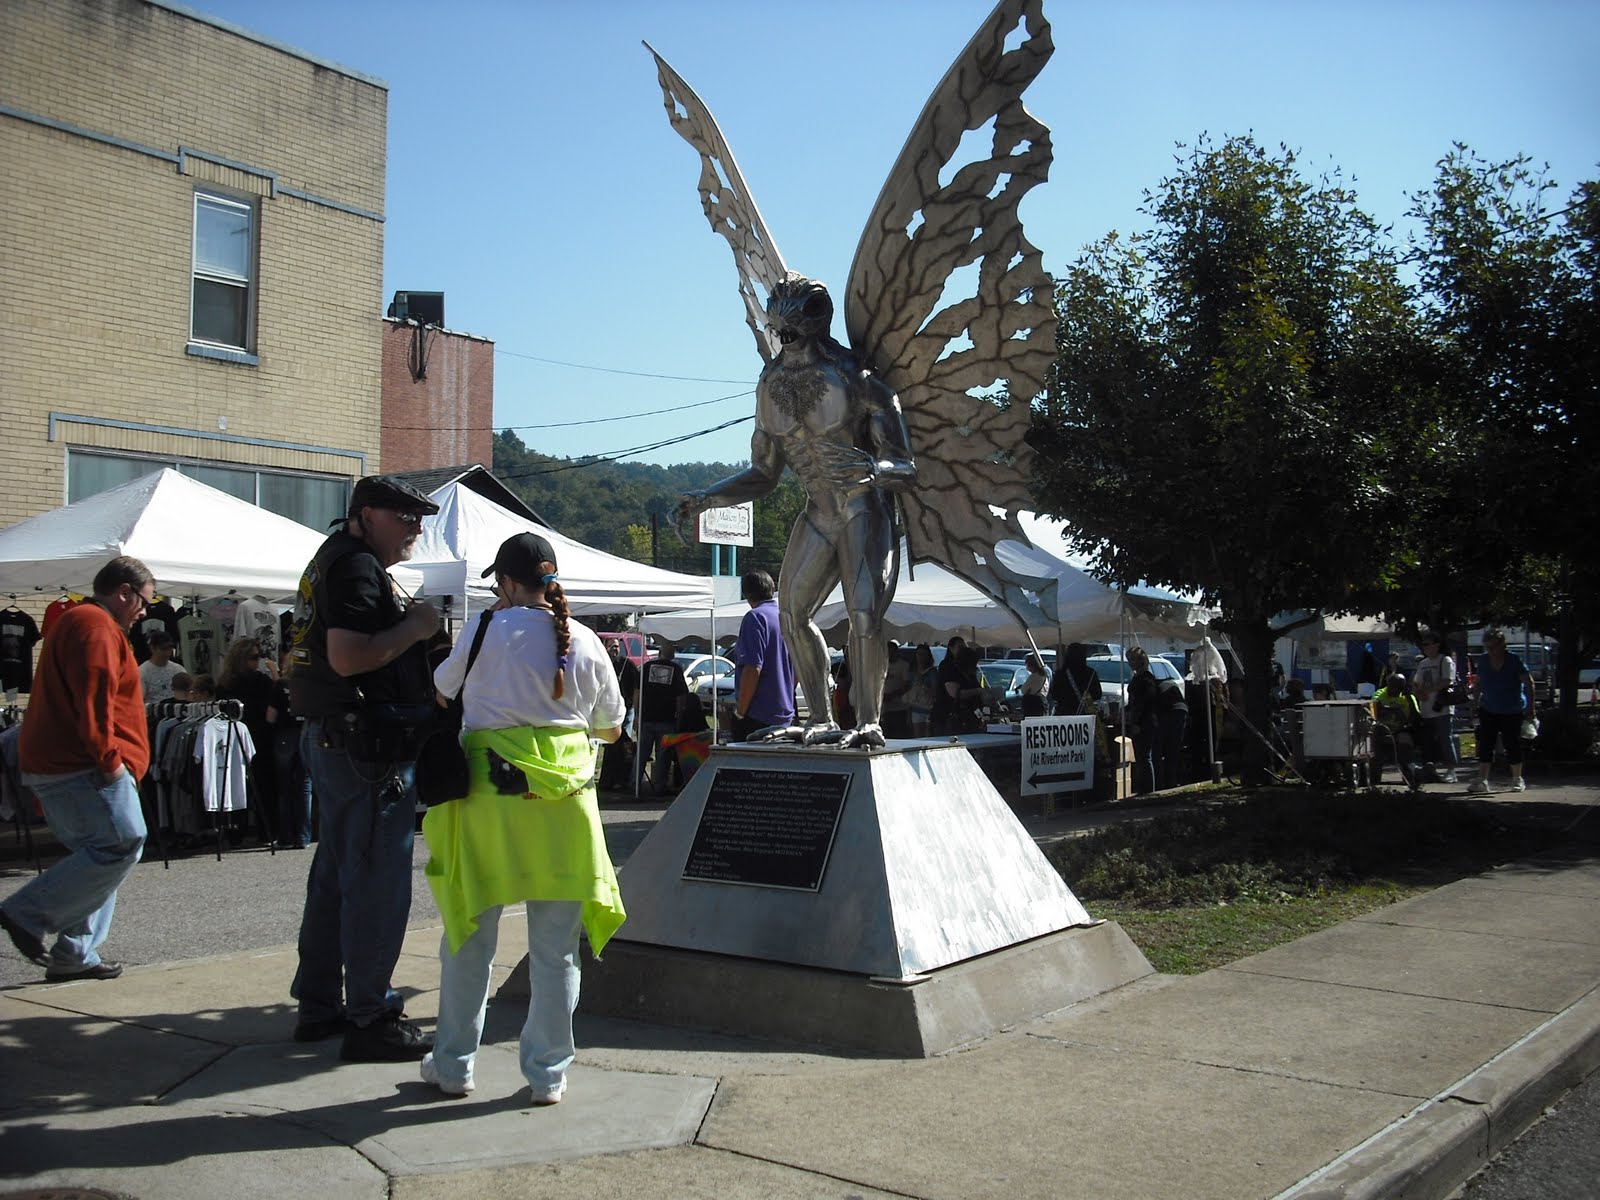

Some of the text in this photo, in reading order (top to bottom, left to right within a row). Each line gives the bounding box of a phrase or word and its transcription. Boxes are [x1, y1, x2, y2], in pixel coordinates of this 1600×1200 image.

[1026, 723, 1089, 749] RESTROOMS
[1030, 750, 1086, 769] (At Riverfront Park)
